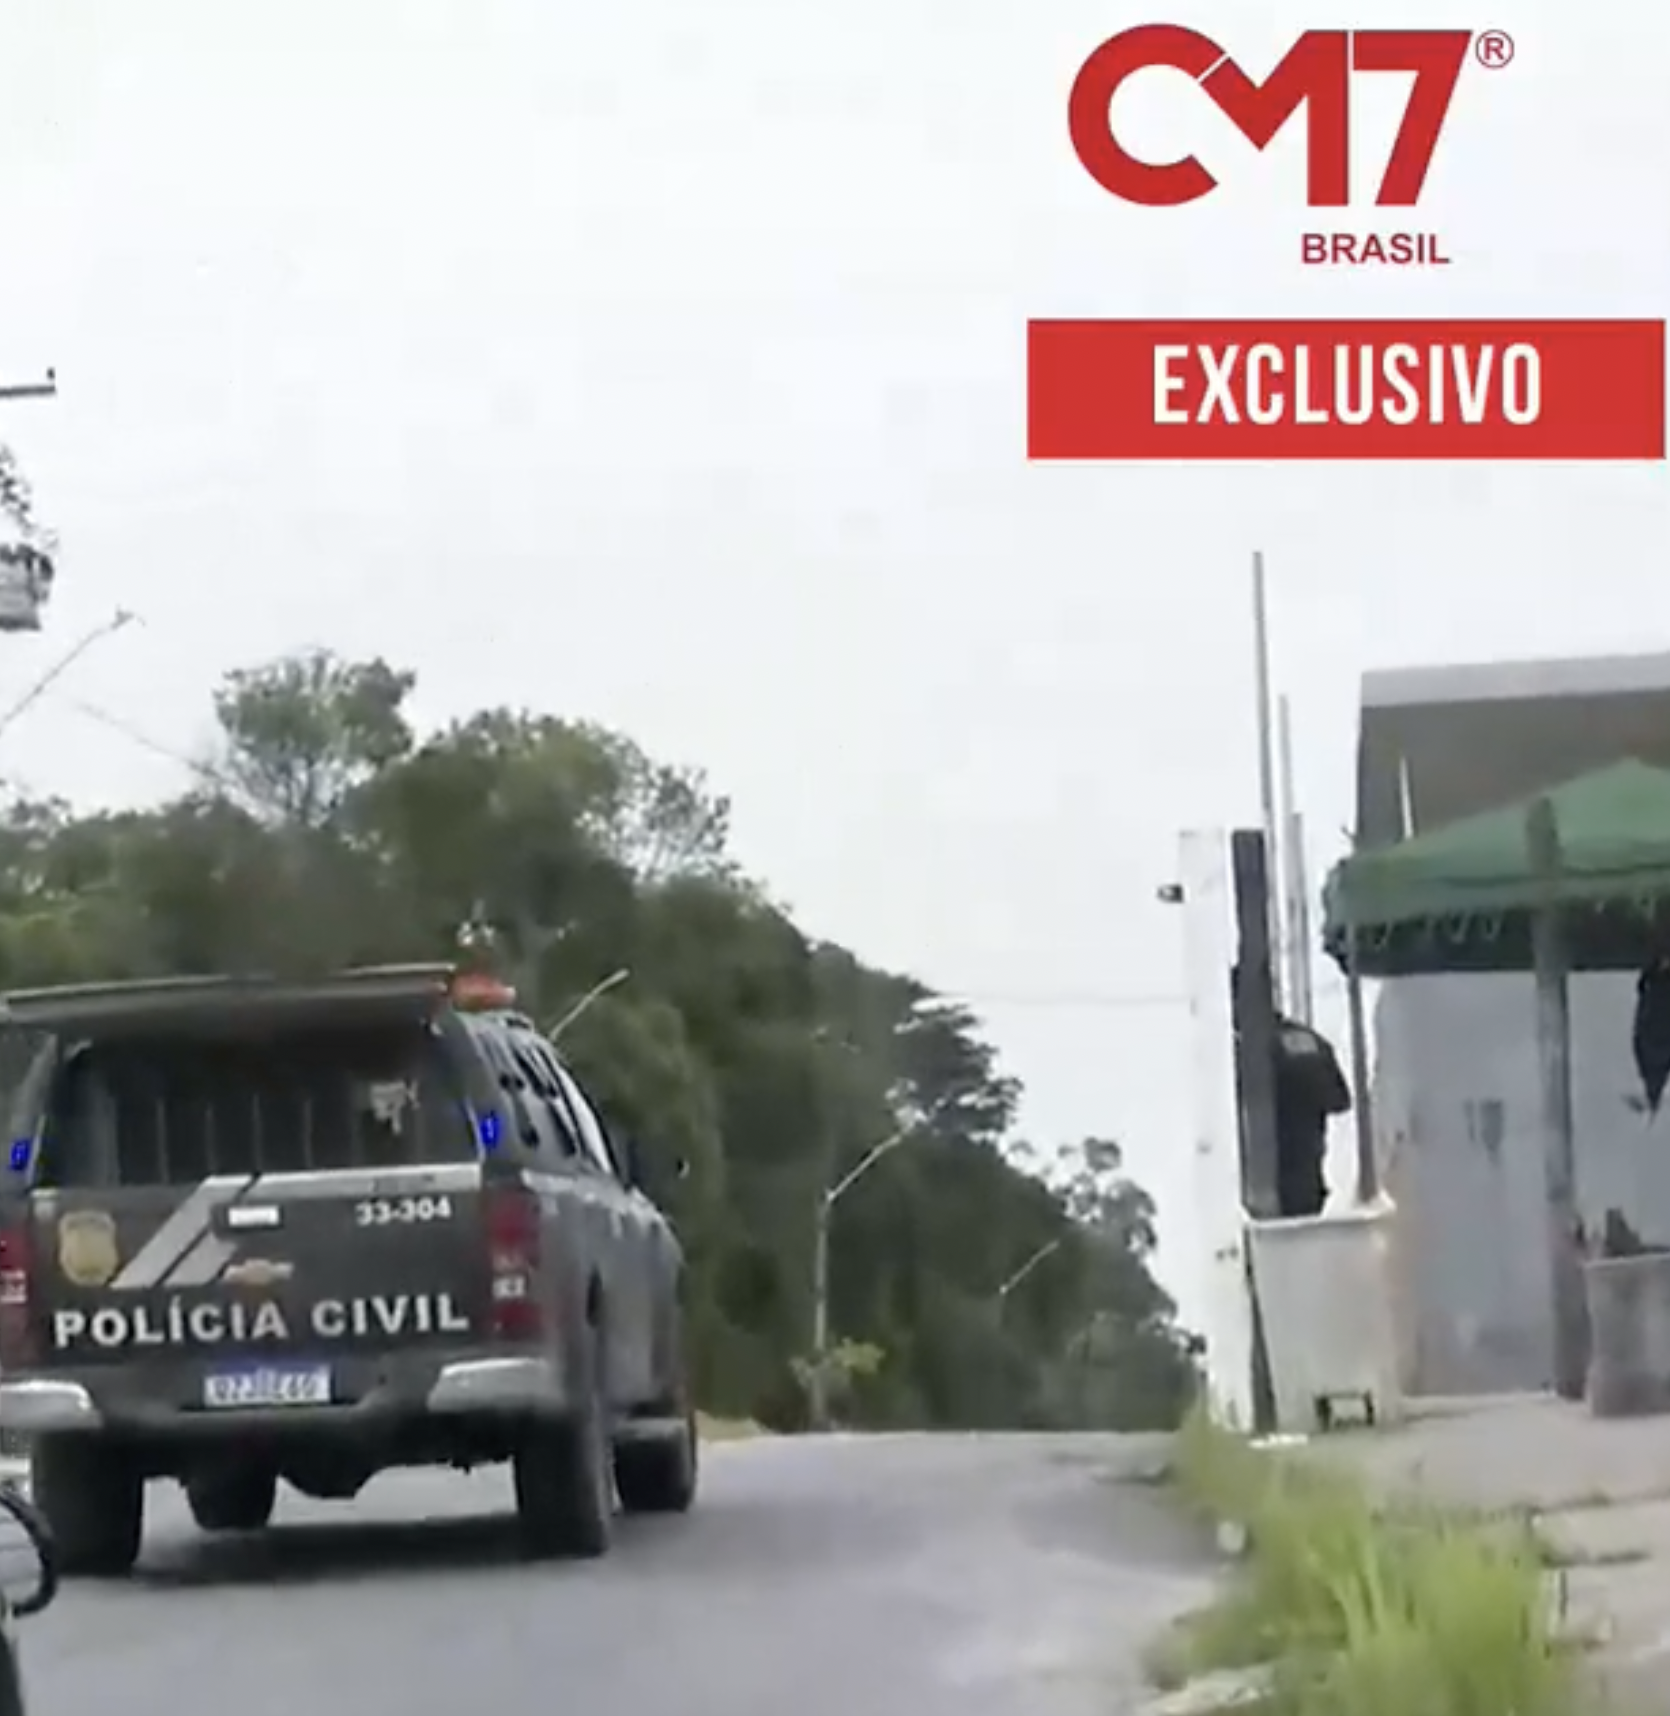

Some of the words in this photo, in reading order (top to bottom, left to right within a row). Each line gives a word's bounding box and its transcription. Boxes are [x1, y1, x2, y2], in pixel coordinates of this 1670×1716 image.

[355, 1196, 451, 1226] 33-304
[53, 1297, 288, 1348] POLÍCIA
[311, 1293, 470, 1337] CIVIL
